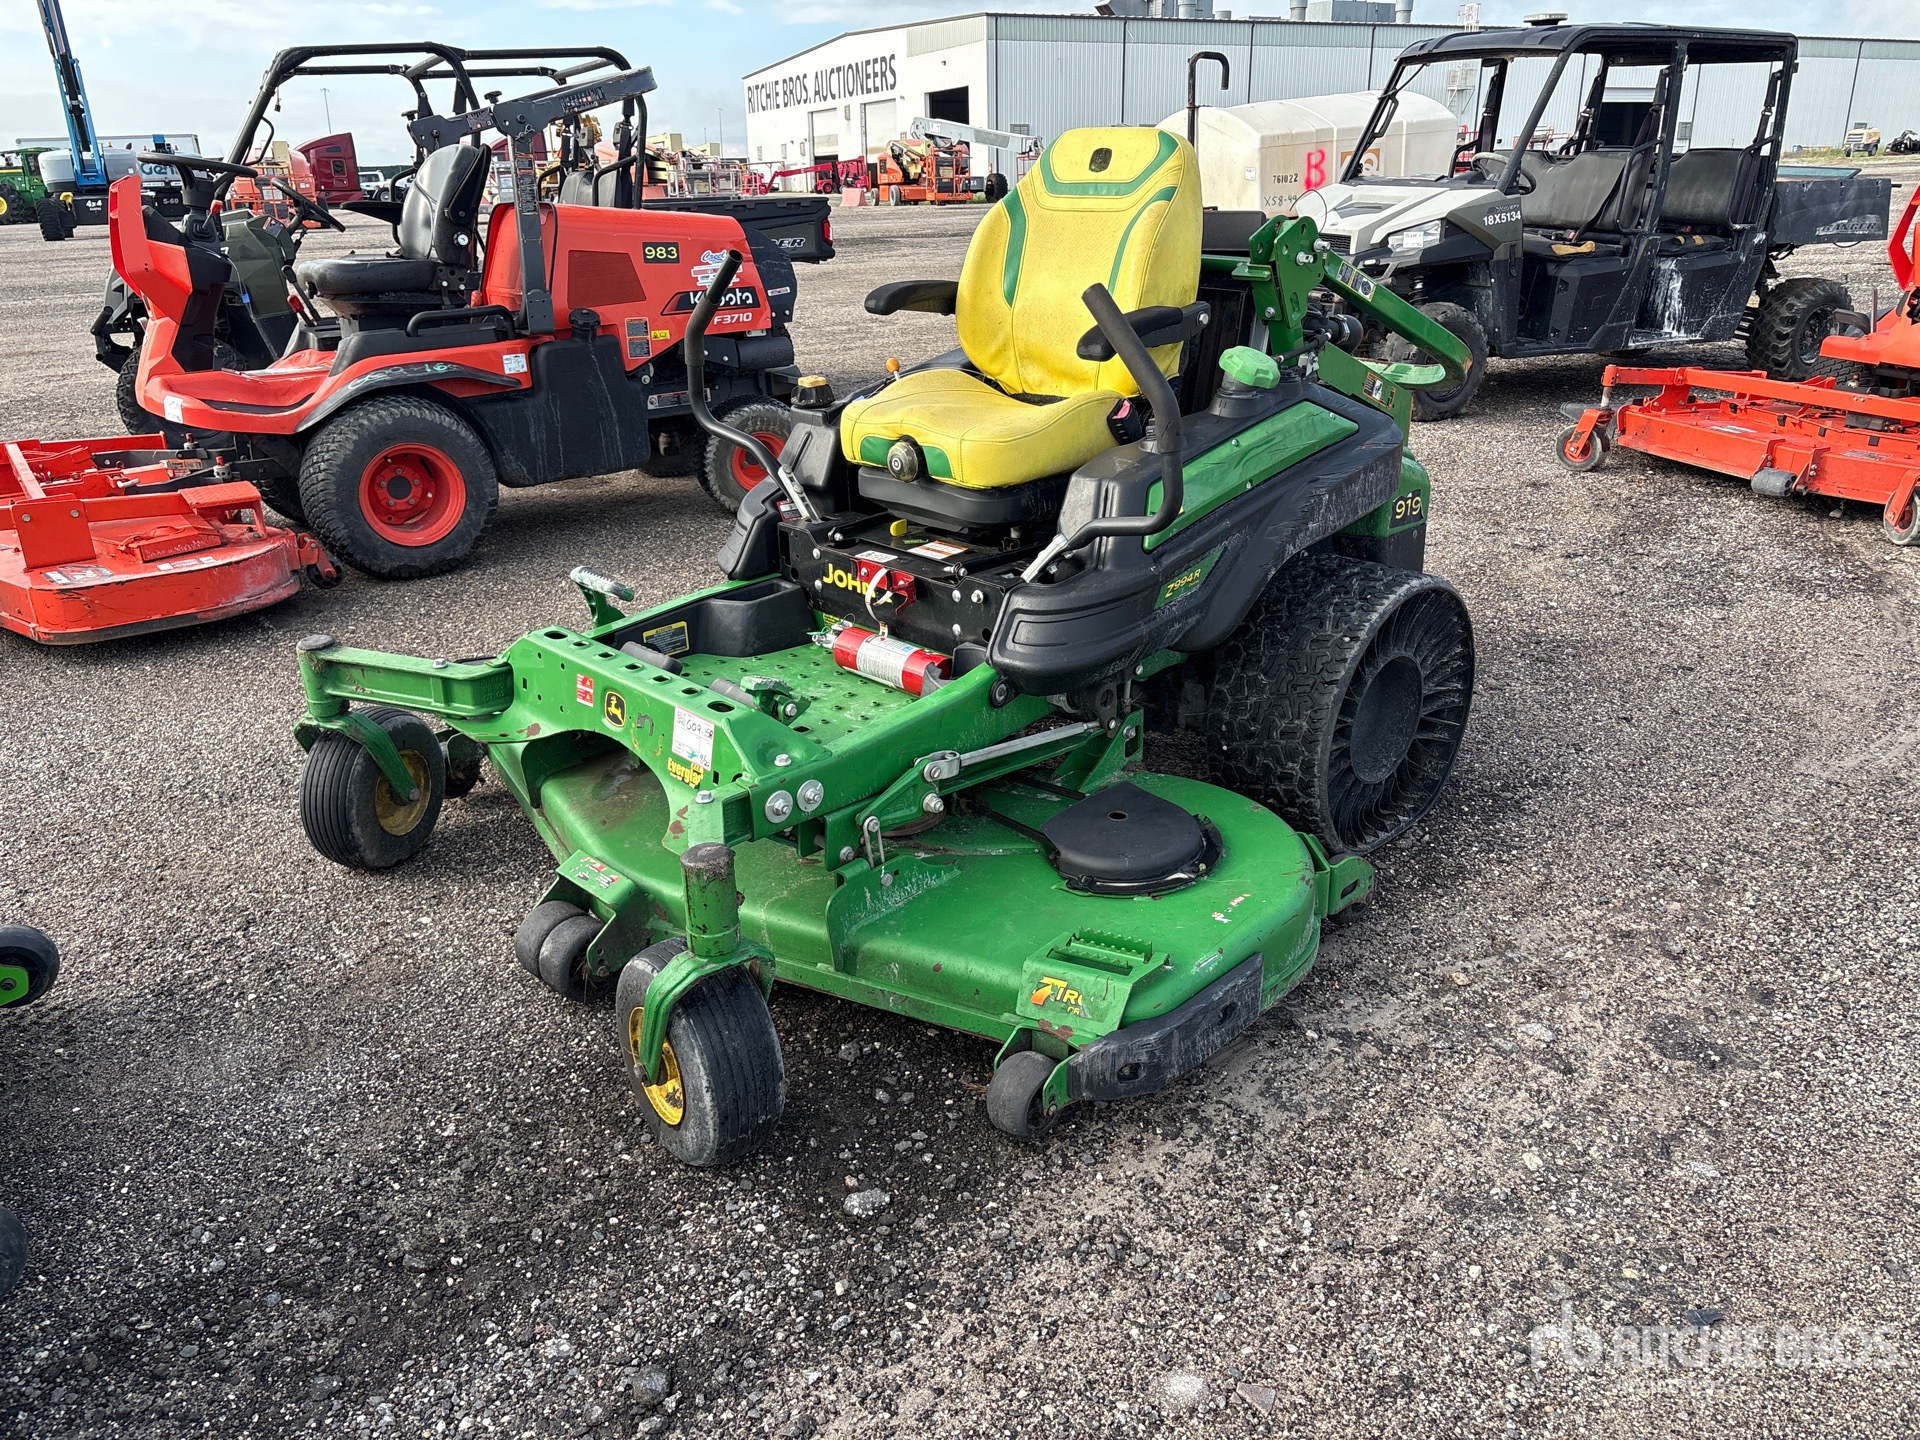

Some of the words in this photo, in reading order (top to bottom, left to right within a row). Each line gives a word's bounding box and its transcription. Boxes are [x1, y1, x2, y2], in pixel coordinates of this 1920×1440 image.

[747, 80, 781, 114] RITCHIE
[782, 73, 812, 108] BROS.
[814, 53, 897, 103] AUCTIONEERS
[1304, 148, 1327, 191] B
[1272, 172, 1299, 184] 761022
[85, 199, 103, 208] 4x4
[162, 197, 179, 205] S-60
[1483, 210, 1522, 226] 18X5134
[644, 246, 678, 259] 983
[689, 288, 753, 307] Kota
[713, 312, 752, 325] F3710
[1395, 496, 1422, 519] 919
